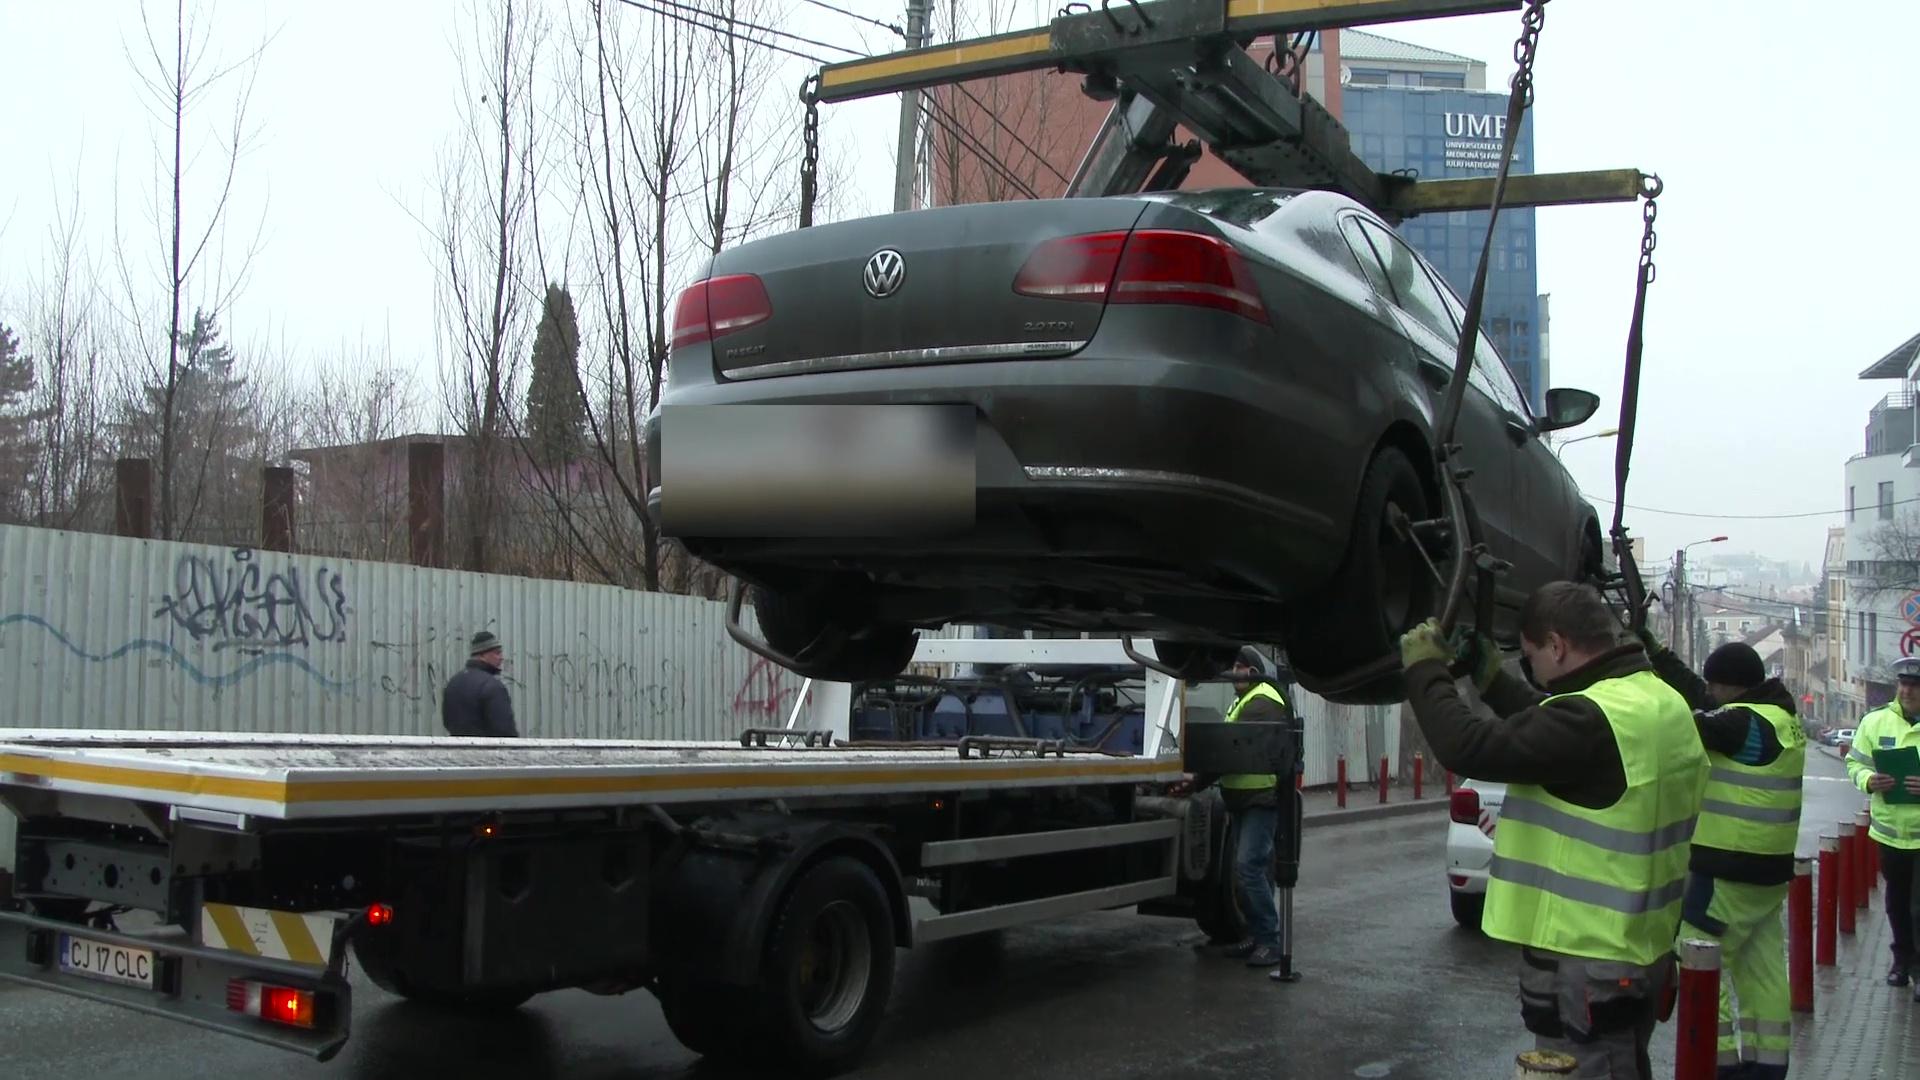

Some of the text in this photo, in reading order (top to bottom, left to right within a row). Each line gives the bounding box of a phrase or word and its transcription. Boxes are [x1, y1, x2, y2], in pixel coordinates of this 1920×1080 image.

[1444, 112, 1508, 139] UMF
[1445, 140, 1496, 151] UNIVERSITATEA
[71, 940, 90, 969] CJ
[95, 946, 110, 973] 17
[114, 950, 149, 980] CLC
